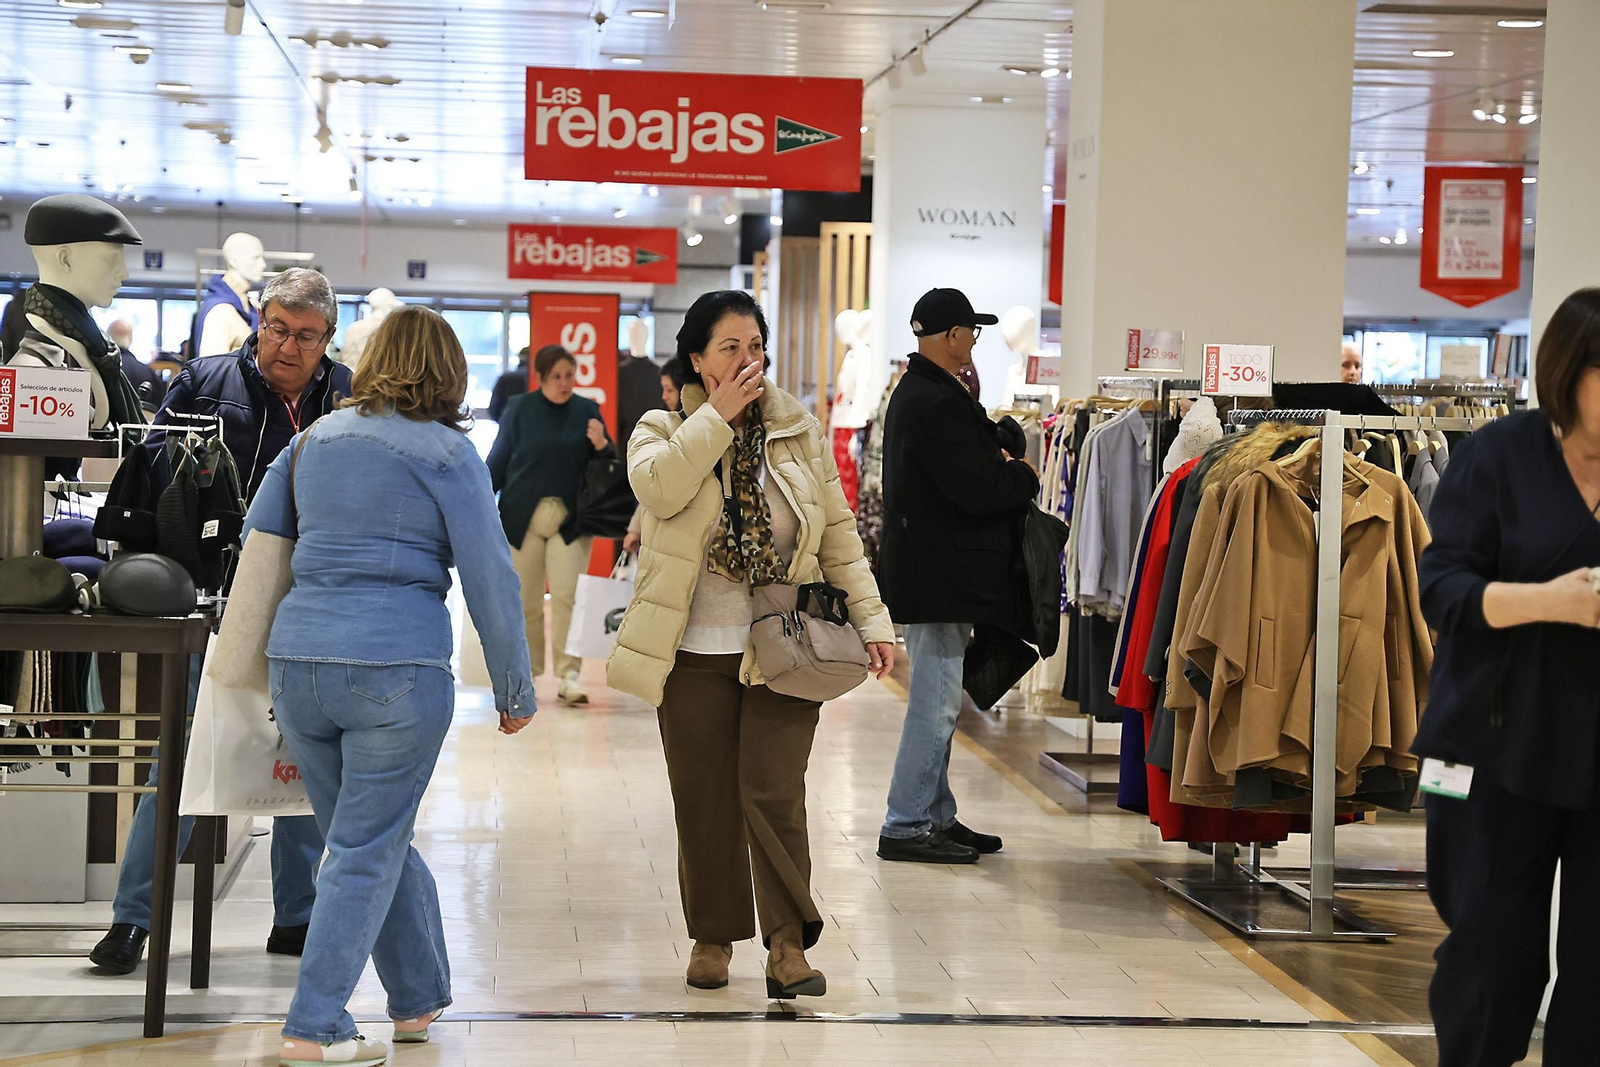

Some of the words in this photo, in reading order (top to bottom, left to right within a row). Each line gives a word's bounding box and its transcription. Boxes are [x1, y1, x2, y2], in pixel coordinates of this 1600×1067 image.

[537, 81, 581, 104] Las
[535, 94, 765, 164] rebajas
[917, 207, 1017, 226] WOMAN
[514, 236, 631, 273] rebajas
[1229, 354, 1262, 365] TODO
[1207, 353, 1216, 390] rebajas
[1222, 366, 1266, 382] -30%
[20, 383, 49, 391] Selección
[0, 378, 12, 425] rebajas
[20, 396, 75, 417] -10%
[272, 758, 303, 785] ka
